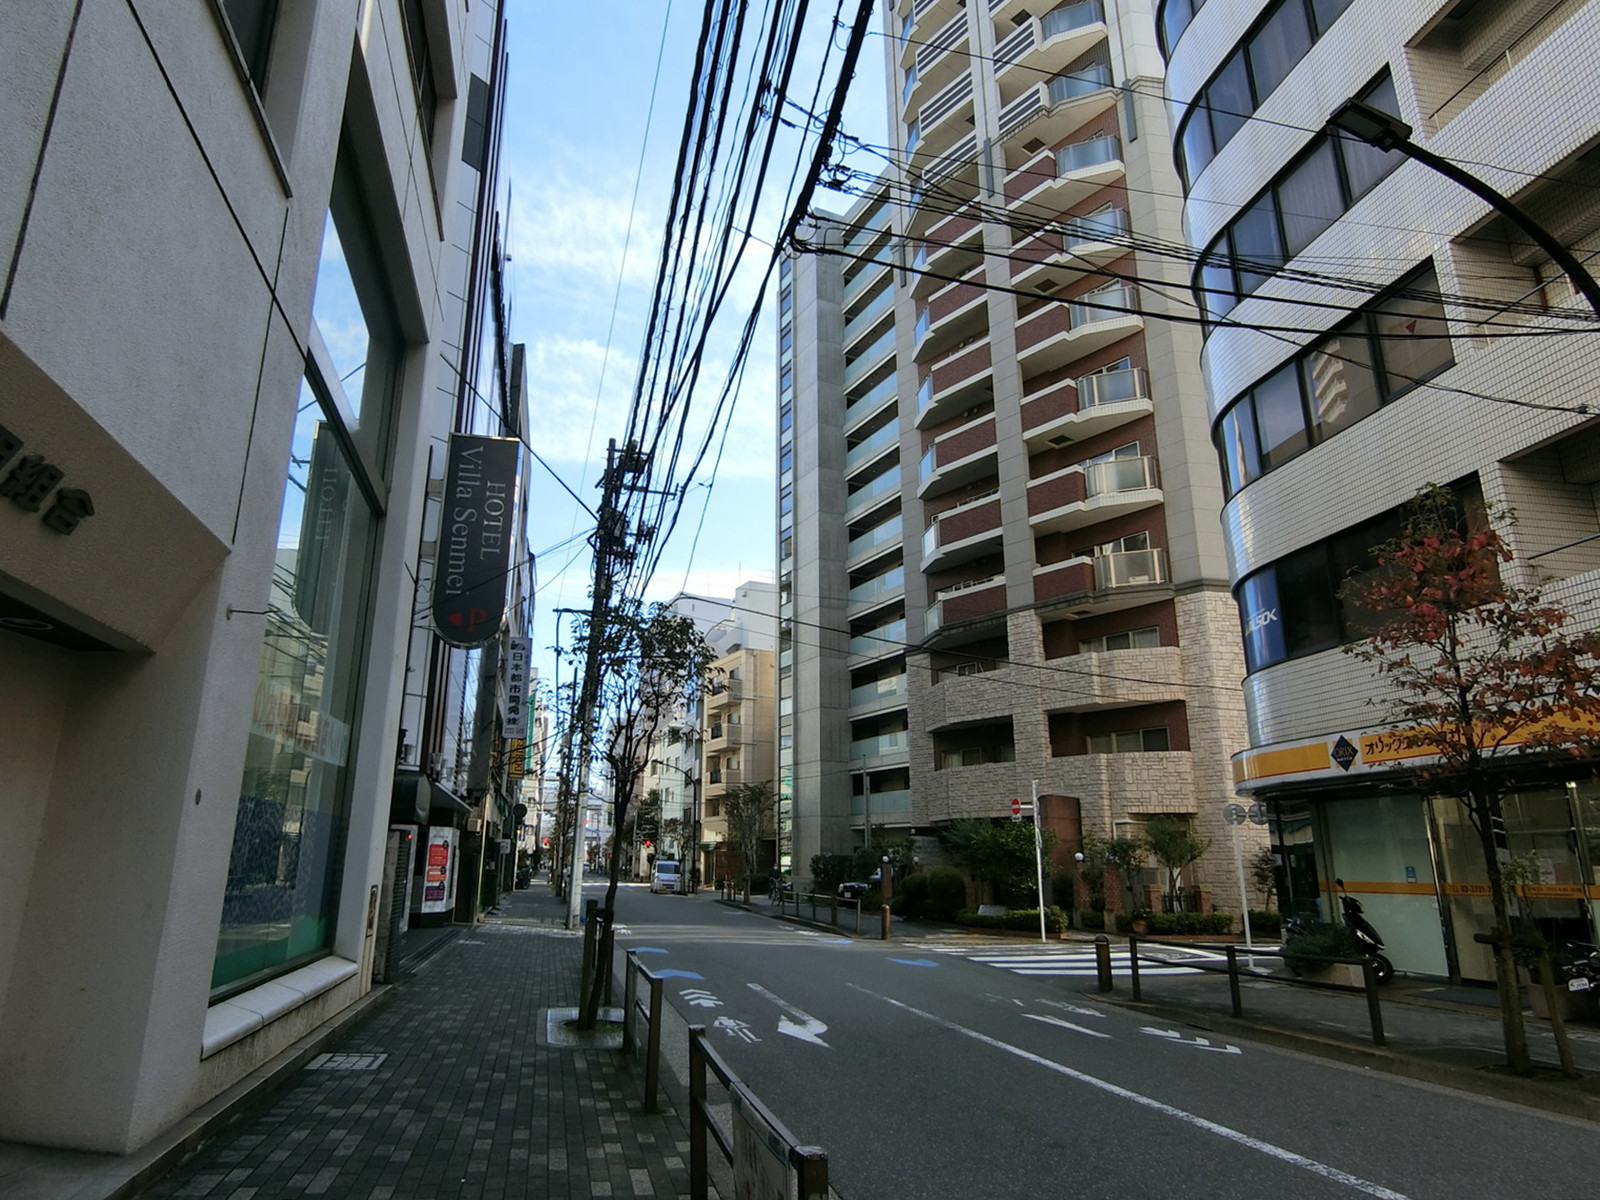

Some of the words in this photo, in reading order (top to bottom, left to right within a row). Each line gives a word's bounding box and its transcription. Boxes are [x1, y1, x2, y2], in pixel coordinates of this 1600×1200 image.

[455, 445, 484, 499] Villa
[446, 506, 477, 596] Senmei
[480, 481, 506, 560] HOTEL
